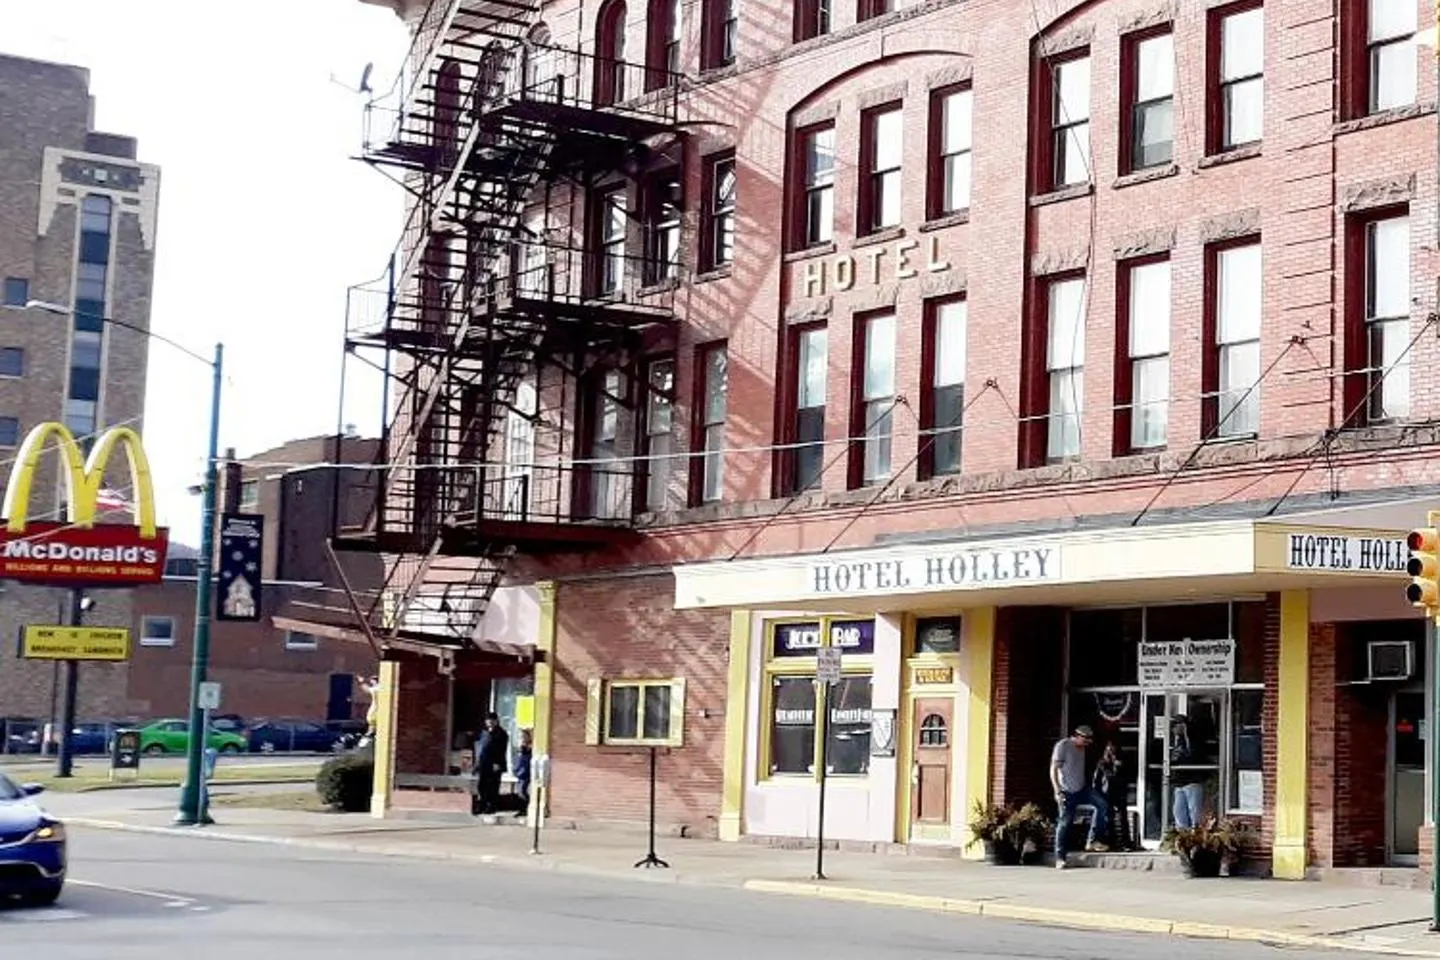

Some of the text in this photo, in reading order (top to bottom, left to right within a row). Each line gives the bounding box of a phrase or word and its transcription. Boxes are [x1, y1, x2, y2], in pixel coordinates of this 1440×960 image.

[805, 237, 952, 298] HOTEL
[3, 540, 157, 564] McDonald's
[814, 548, 1052, 592] HOTEL HOLLEY
[1291, 535, 1413, 571] HOTEL HOLL
